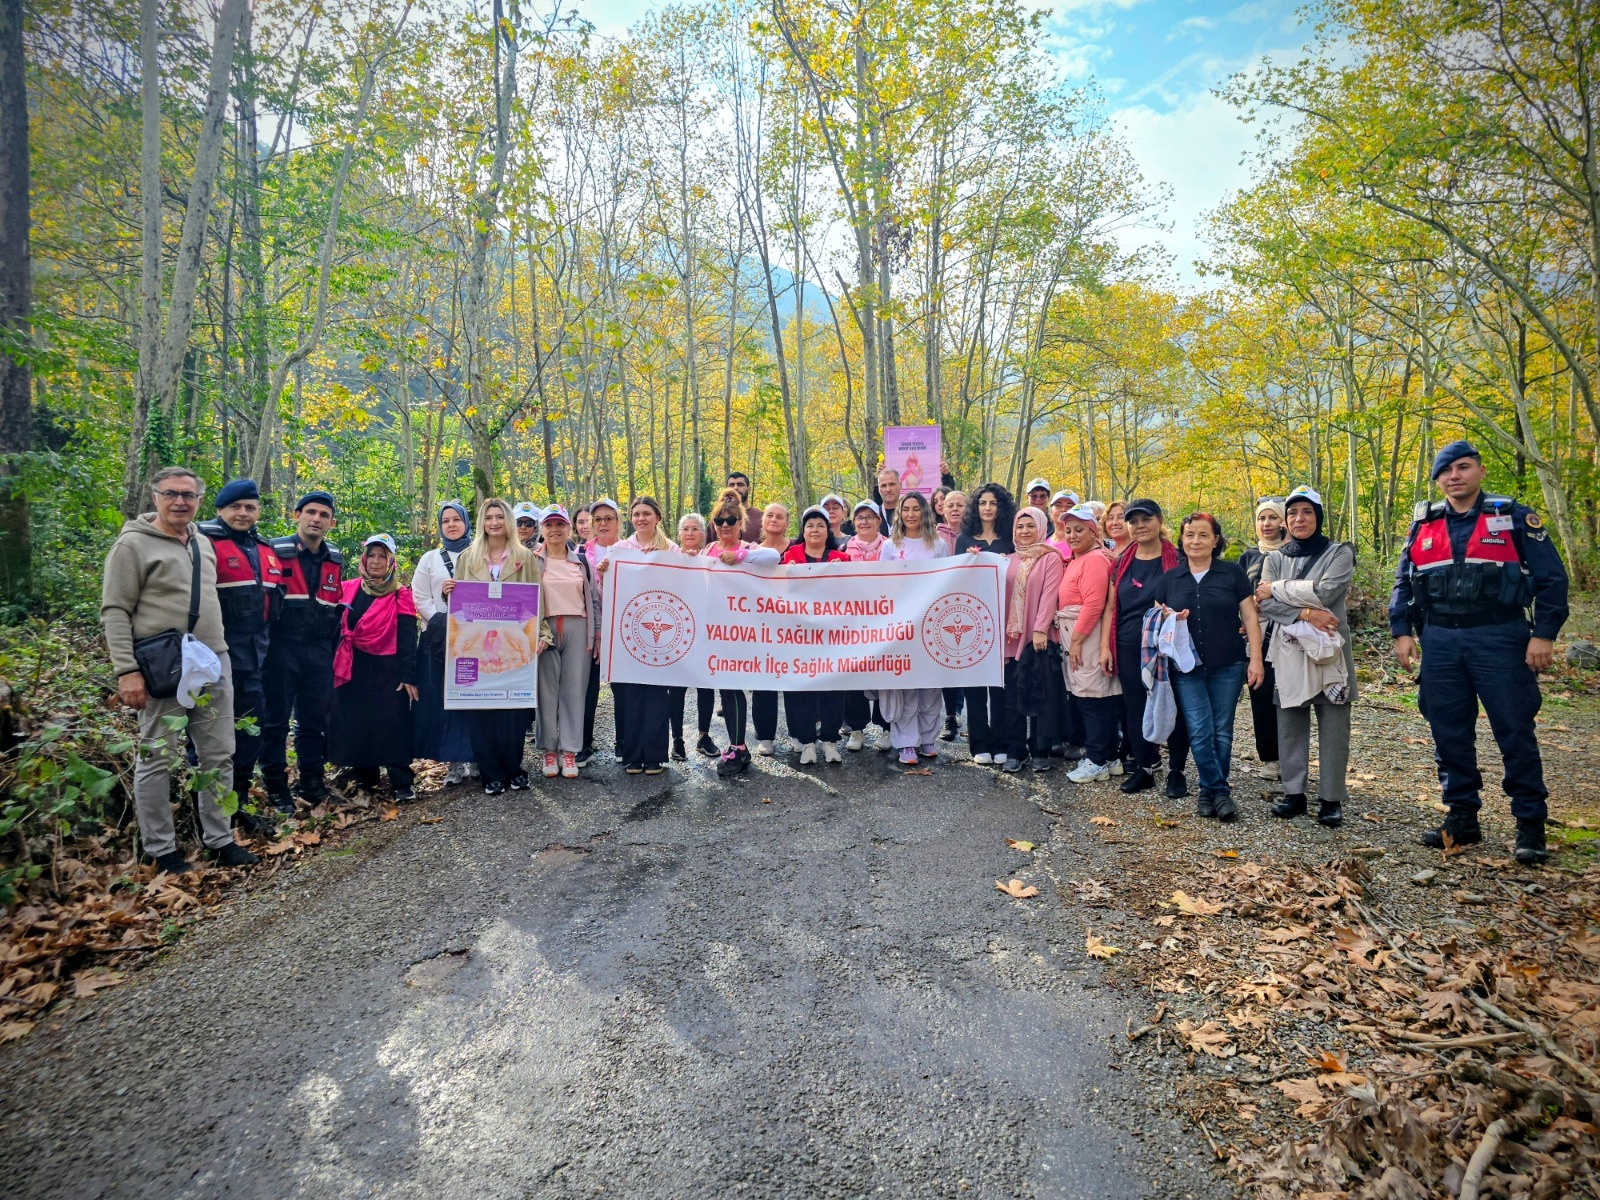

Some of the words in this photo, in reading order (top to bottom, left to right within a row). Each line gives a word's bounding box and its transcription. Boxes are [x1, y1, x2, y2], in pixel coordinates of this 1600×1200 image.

[727, 596, 751, 612] T.C.
[757, 596, 808, 615] SAĞLIK
[813, 595, 894, 616] BAKANLIĞI
[706, 624, 757, 643] YALOVA
[761, 623, 772, 644] İL
[777, 624, 824, 645] SAĞLIK
[828, 621, 914, 645] MÜDÜRLÜĞÜ
[708, 655, 761, 675] Çınarcık
[765, 653, 788, 678] İlçe
[793, 658, 834, 678] Sağlık
[838, 653, 911, 676] Müdürlüğü
